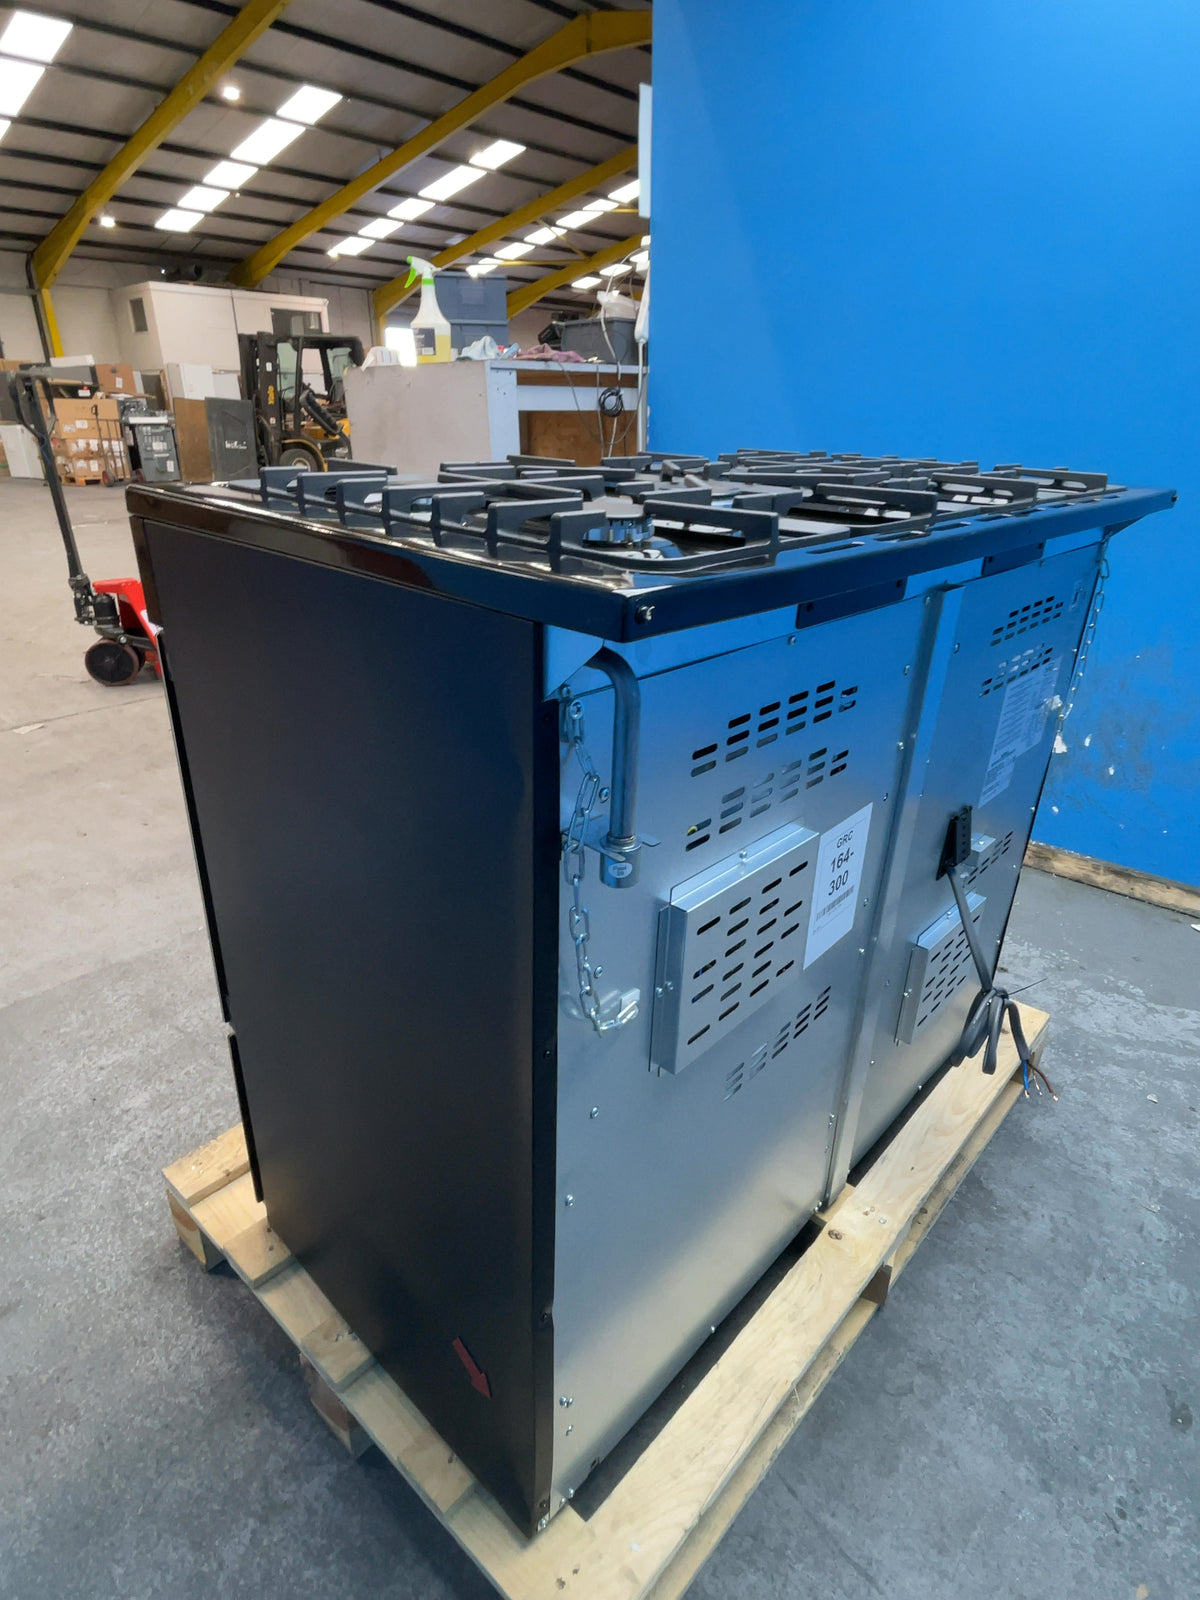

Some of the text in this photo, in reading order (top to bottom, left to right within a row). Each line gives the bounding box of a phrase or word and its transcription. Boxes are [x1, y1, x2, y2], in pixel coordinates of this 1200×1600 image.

[836, 830, 854, 849] GRC
[830, 847, 855, 874] 164-
[828, 870, 849, 897] 300
